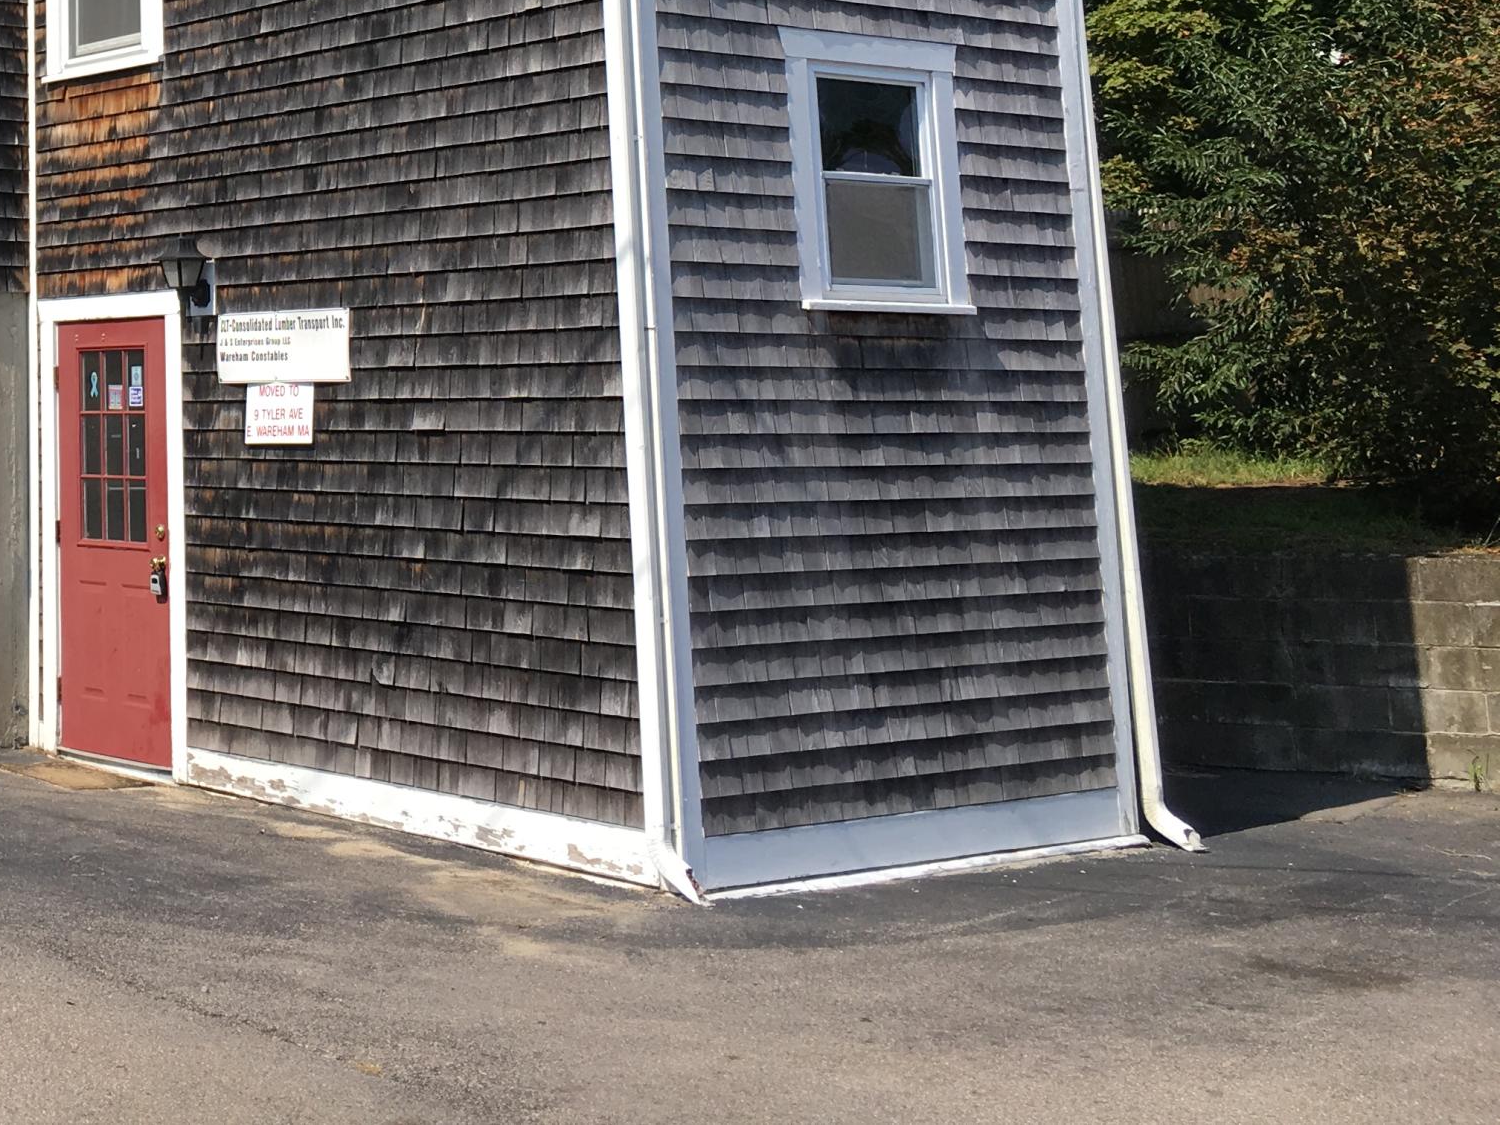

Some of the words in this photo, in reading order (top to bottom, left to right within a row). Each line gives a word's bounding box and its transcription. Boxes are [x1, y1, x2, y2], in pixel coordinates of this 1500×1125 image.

[275, 316, 296, 330] Lumber
[297, 315, 329, 331] Transport
[331, 315, 345, 329] Inc.
[234, 338, 264, 347] Enterprises
[265, 337, 281, 346] Group
[282, 336, 291, 345] LLC
[219, 352, 249, 362] Wareham
[251, 350, 288, 362] Constables
[259, 385, 285, 397] MOVED
[289, 385, 299, 397] TO
[254, 409, 259, 421] 9
[262, 408, 286, 420] TYLER
[289, 408, 304, 420] AVE
[256, 425, 295, 437] WAREHAM
[297, 425, 310, 436] MA
